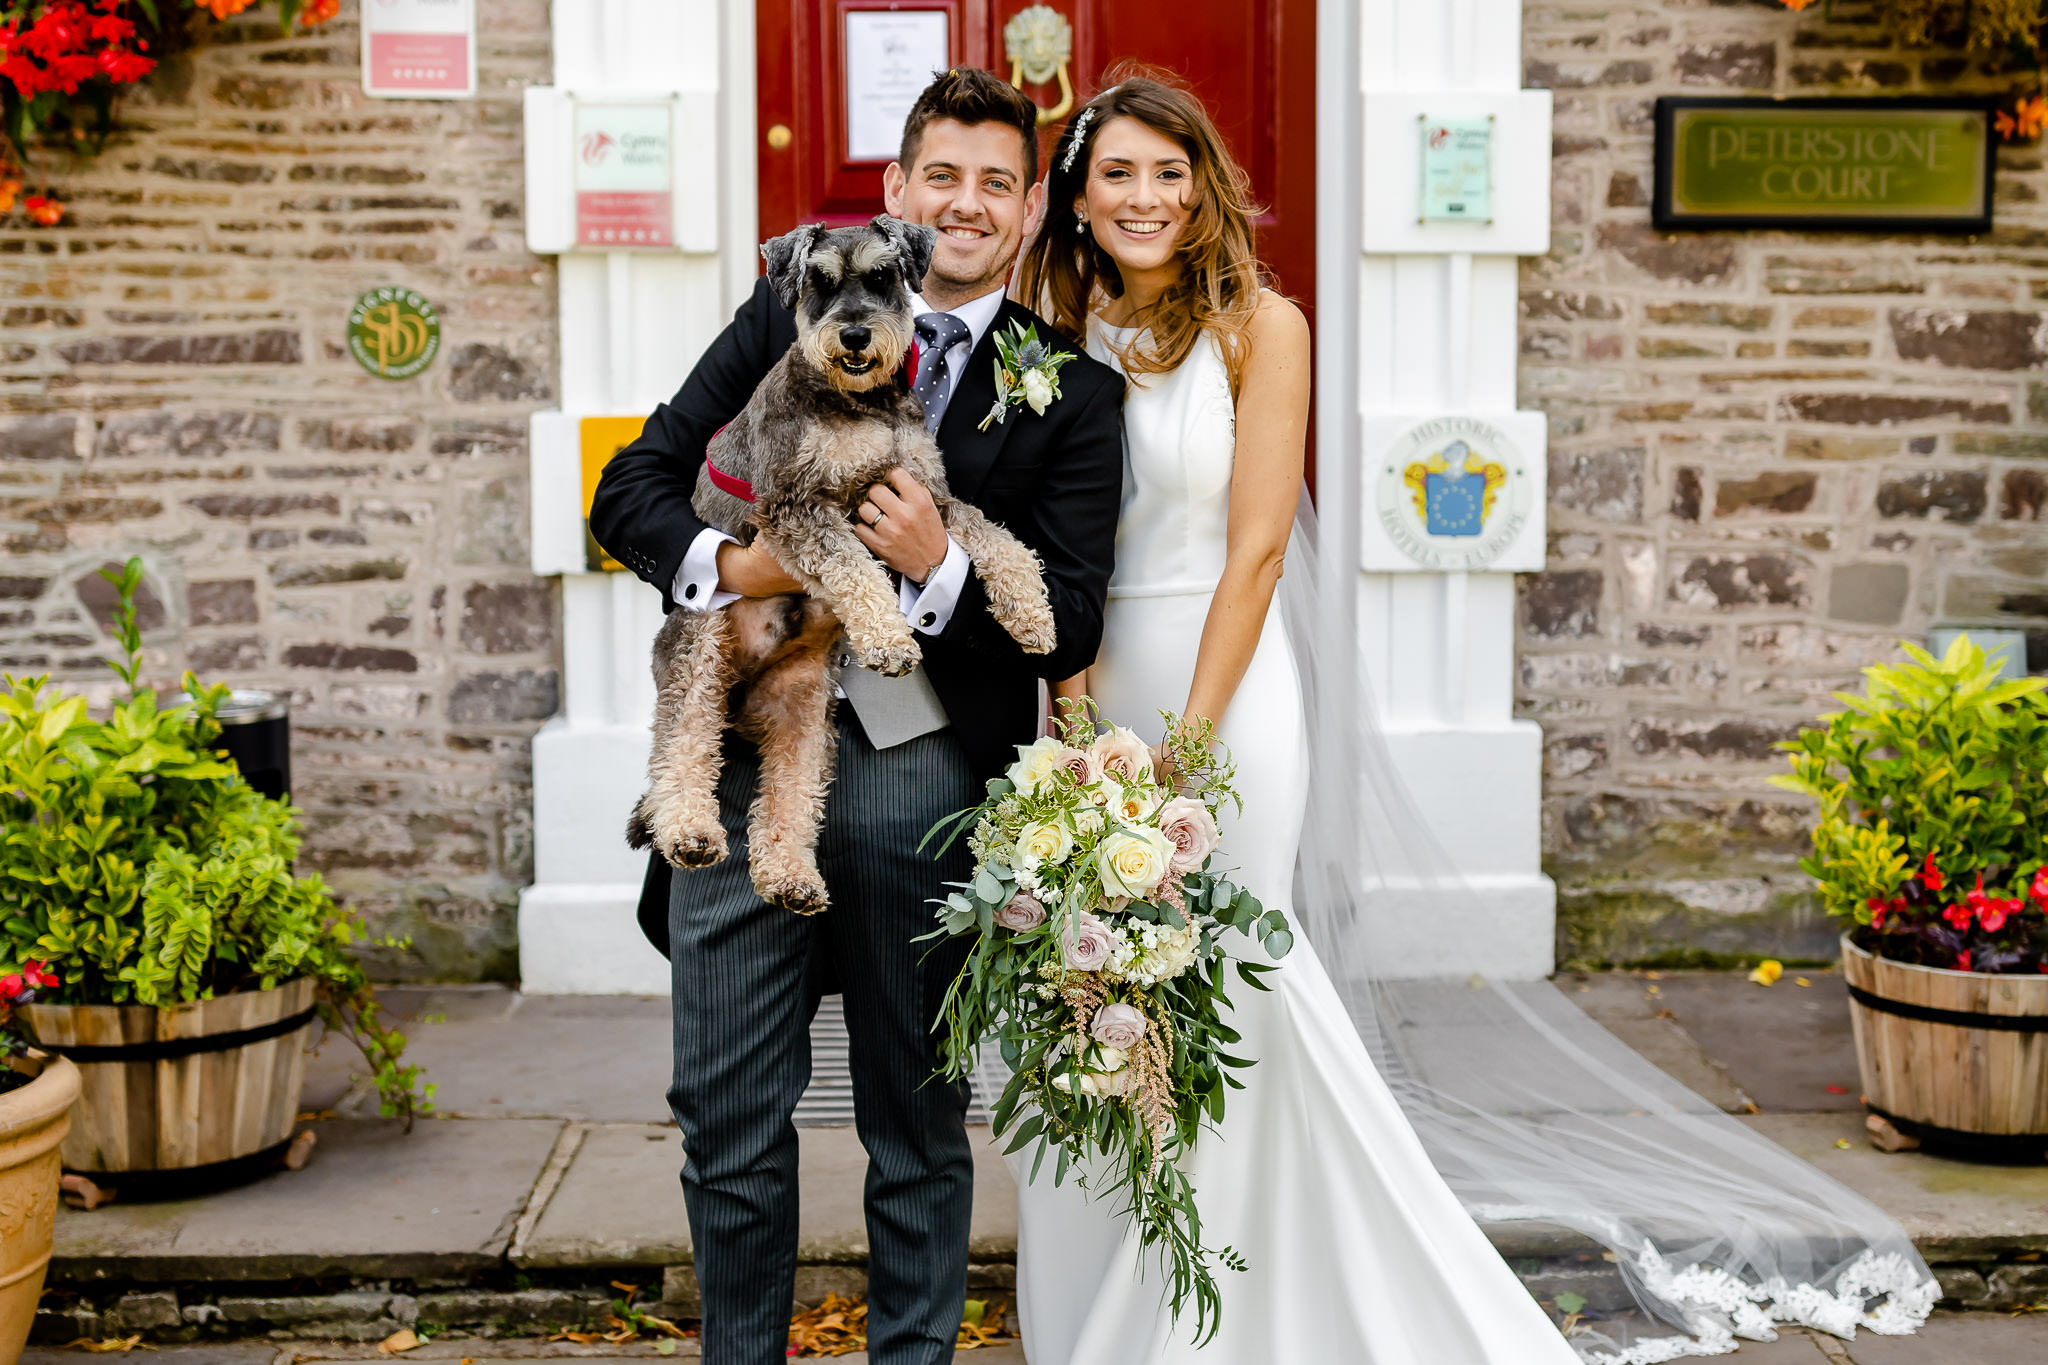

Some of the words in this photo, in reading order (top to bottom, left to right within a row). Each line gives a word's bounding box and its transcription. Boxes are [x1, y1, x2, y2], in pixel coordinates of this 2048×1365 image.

[1708, 126, 1952, 170] PETERSTONE
[1762, 164, 1896, 199] COURT
[1409, 417, 1506, 444] HISTORIC
